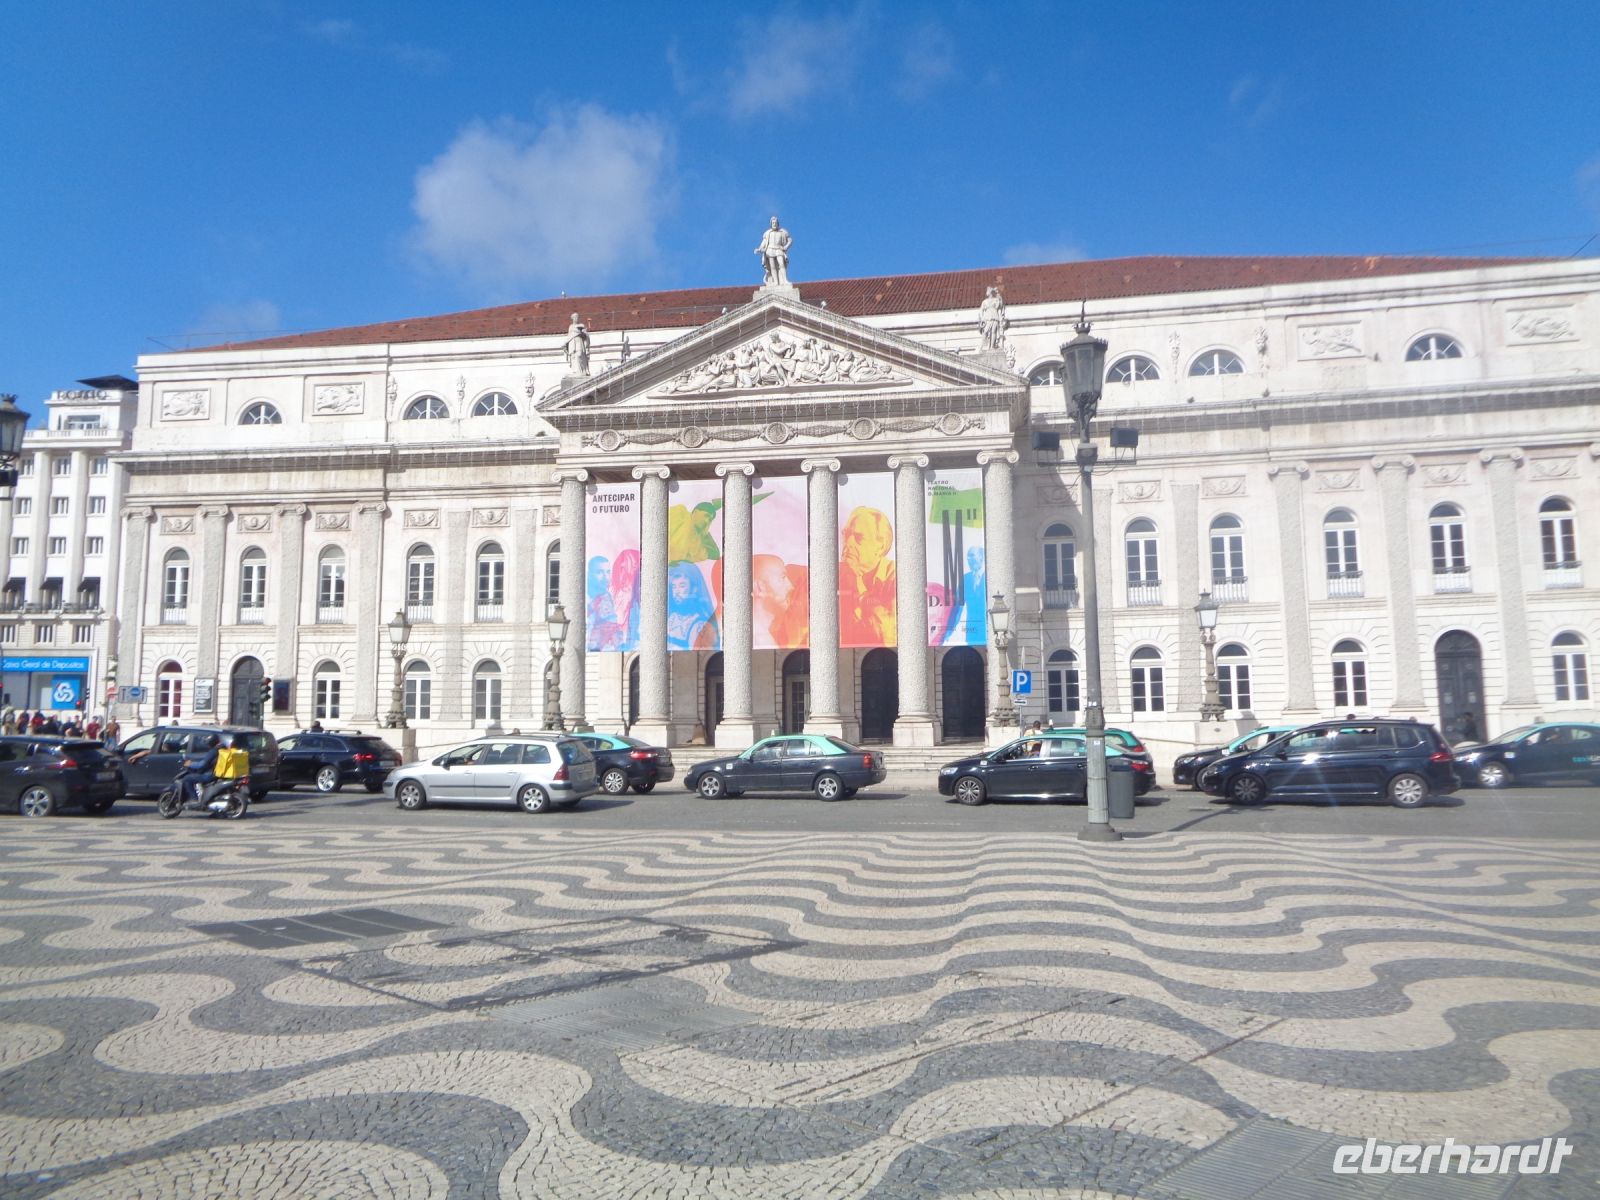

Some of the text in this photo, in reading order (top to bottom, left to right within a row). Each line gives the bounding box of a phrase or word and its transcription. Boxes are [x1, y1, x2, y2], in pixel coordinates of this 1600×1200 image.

[592, 493, 635, 503] ANTECIPAR
[592, 504, 630, 514] O FUTURO
[1016, 672, 1028, 692] P
